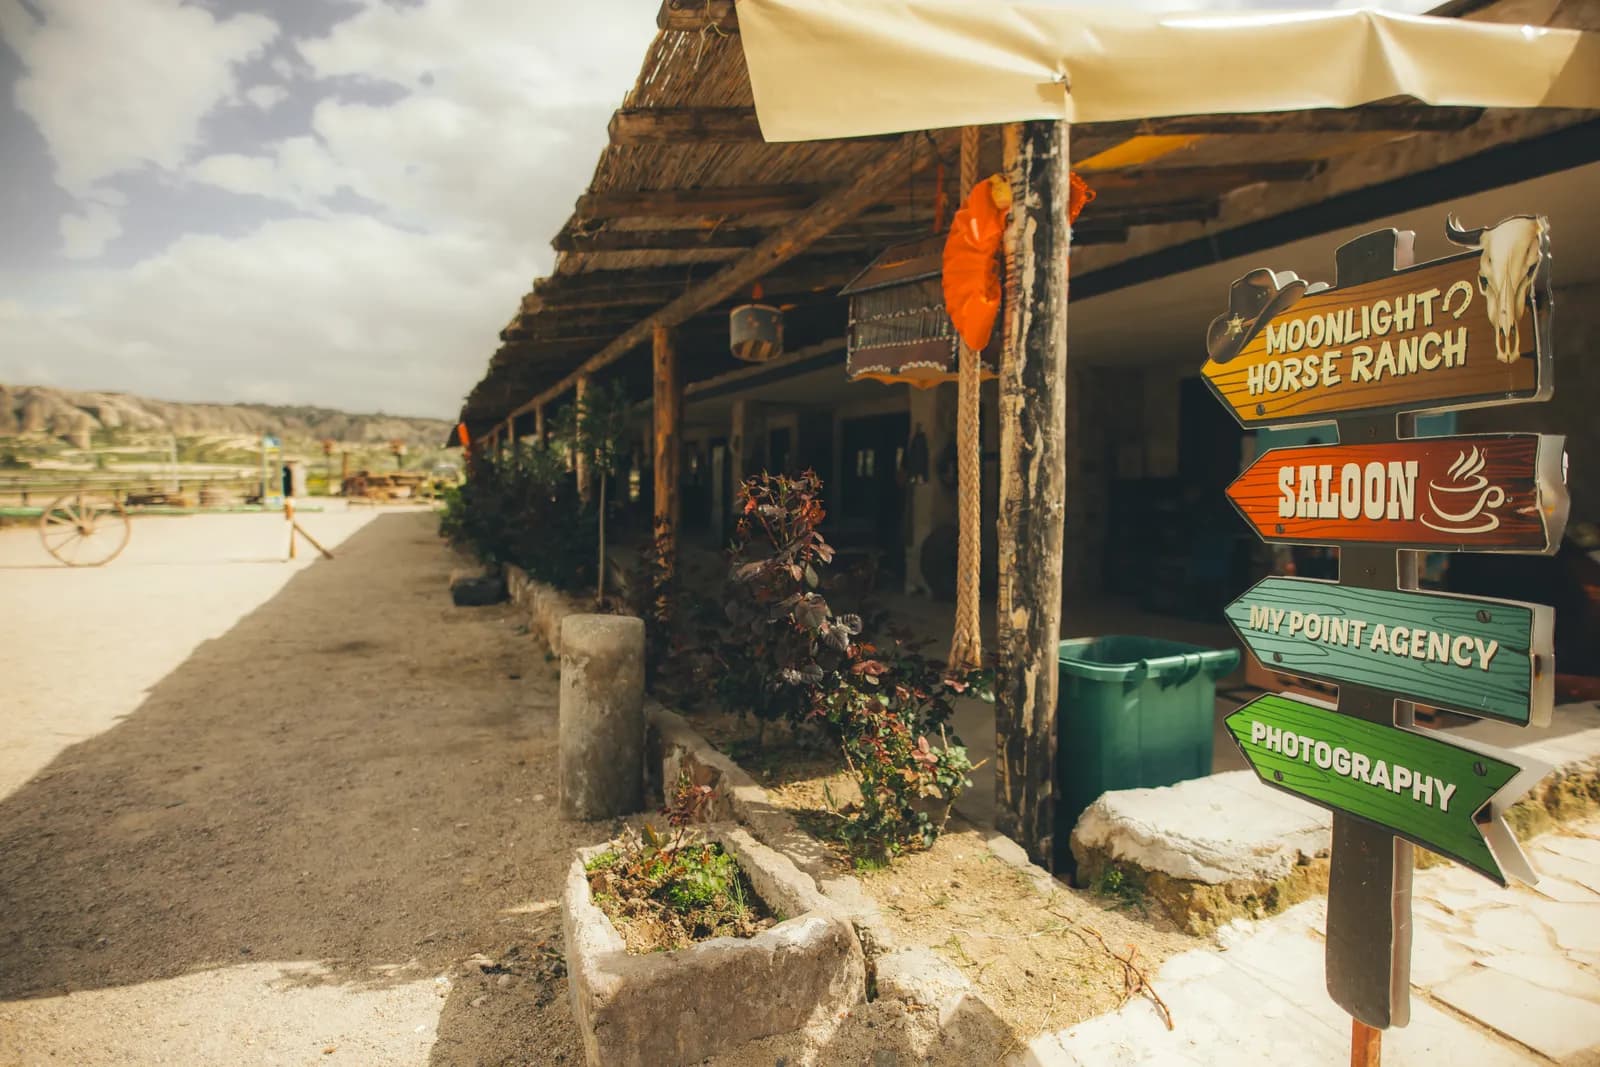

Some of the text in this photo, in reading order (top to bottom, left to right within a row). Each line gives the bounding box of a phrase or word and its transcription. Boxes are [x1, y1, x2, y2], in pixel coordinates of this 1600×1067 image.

[1266, 288, 1440, 354] MOONLIGHT
[1247, 327, 1467, 395] HORSE RANCH
[1278, 461, 1418, 520] SALOON
[1249, 605, 1498, 671] MY POINT AGENCY
[1251, 720, 1456, 811] PHOTOGRAPHY
